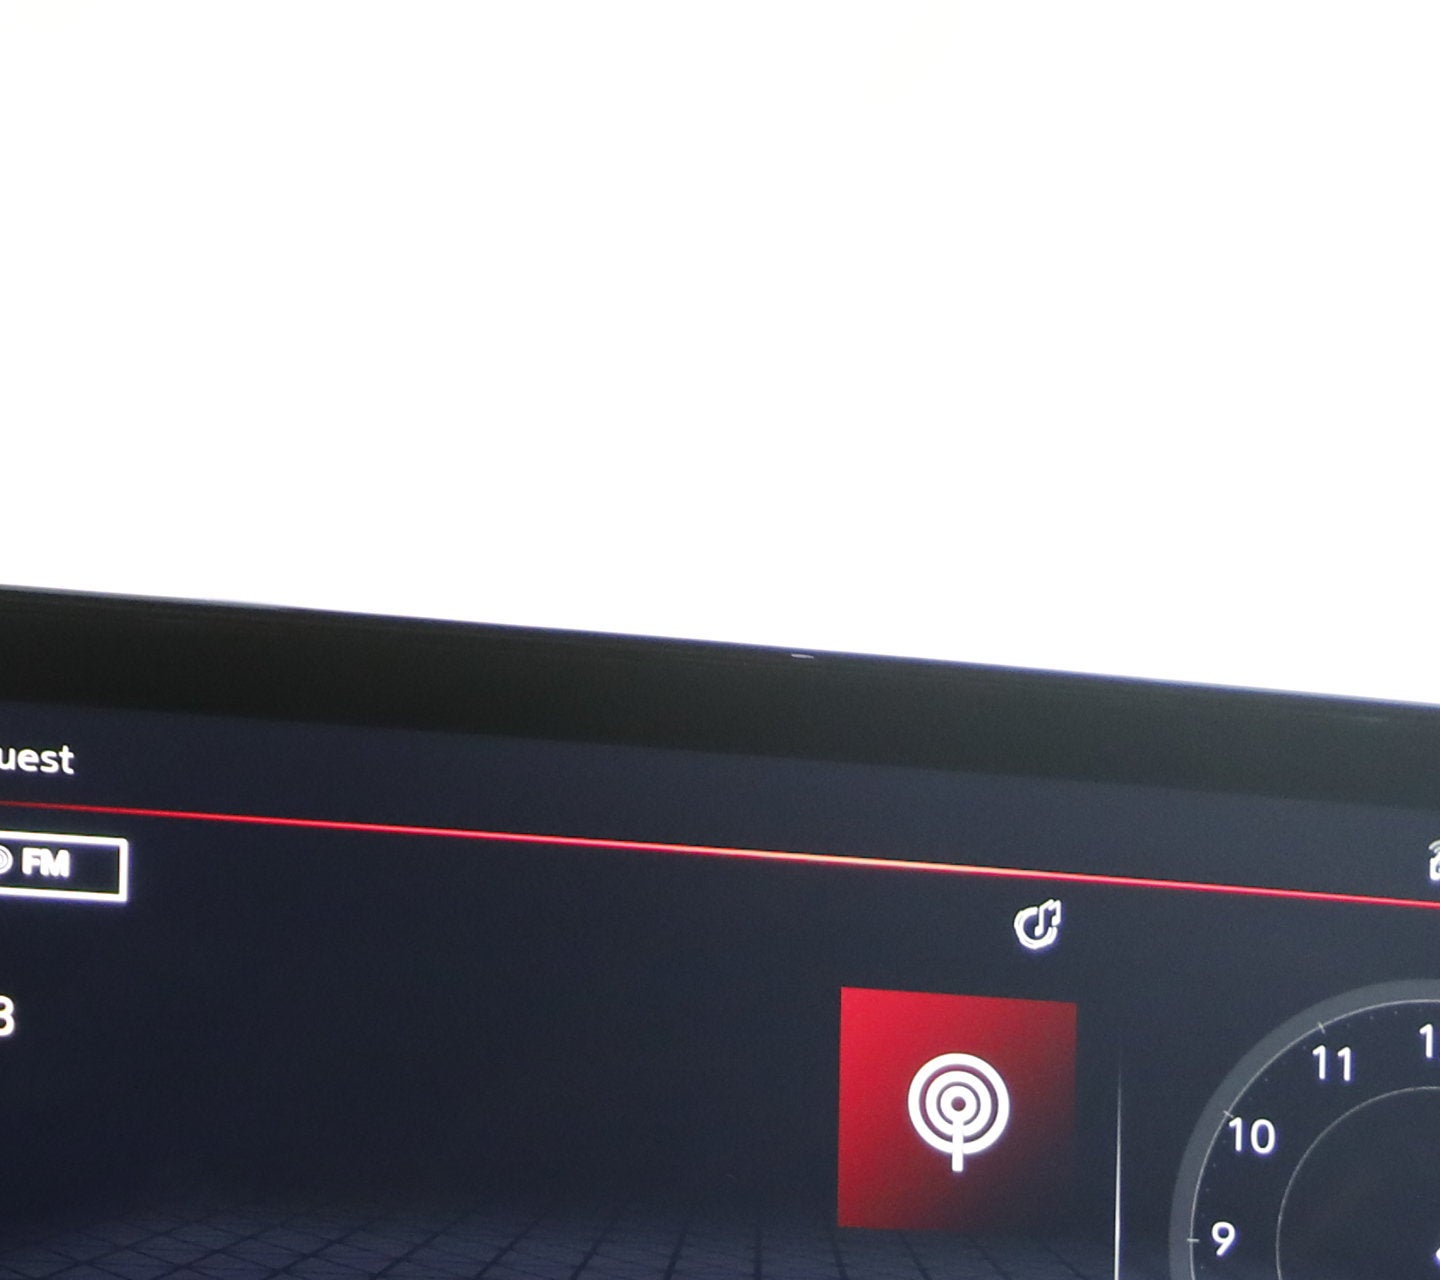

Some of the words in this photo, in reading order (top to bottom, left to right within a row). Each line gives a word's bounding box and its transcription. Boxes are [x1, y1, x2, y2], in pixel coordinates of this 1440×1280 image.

[22, 848, 70, 878] FM
[1313, 1046, 1351, 1081] 11
[1228, 1114, 1276, 1155] 10
[1212, 1222, 1235, 1256] 9
